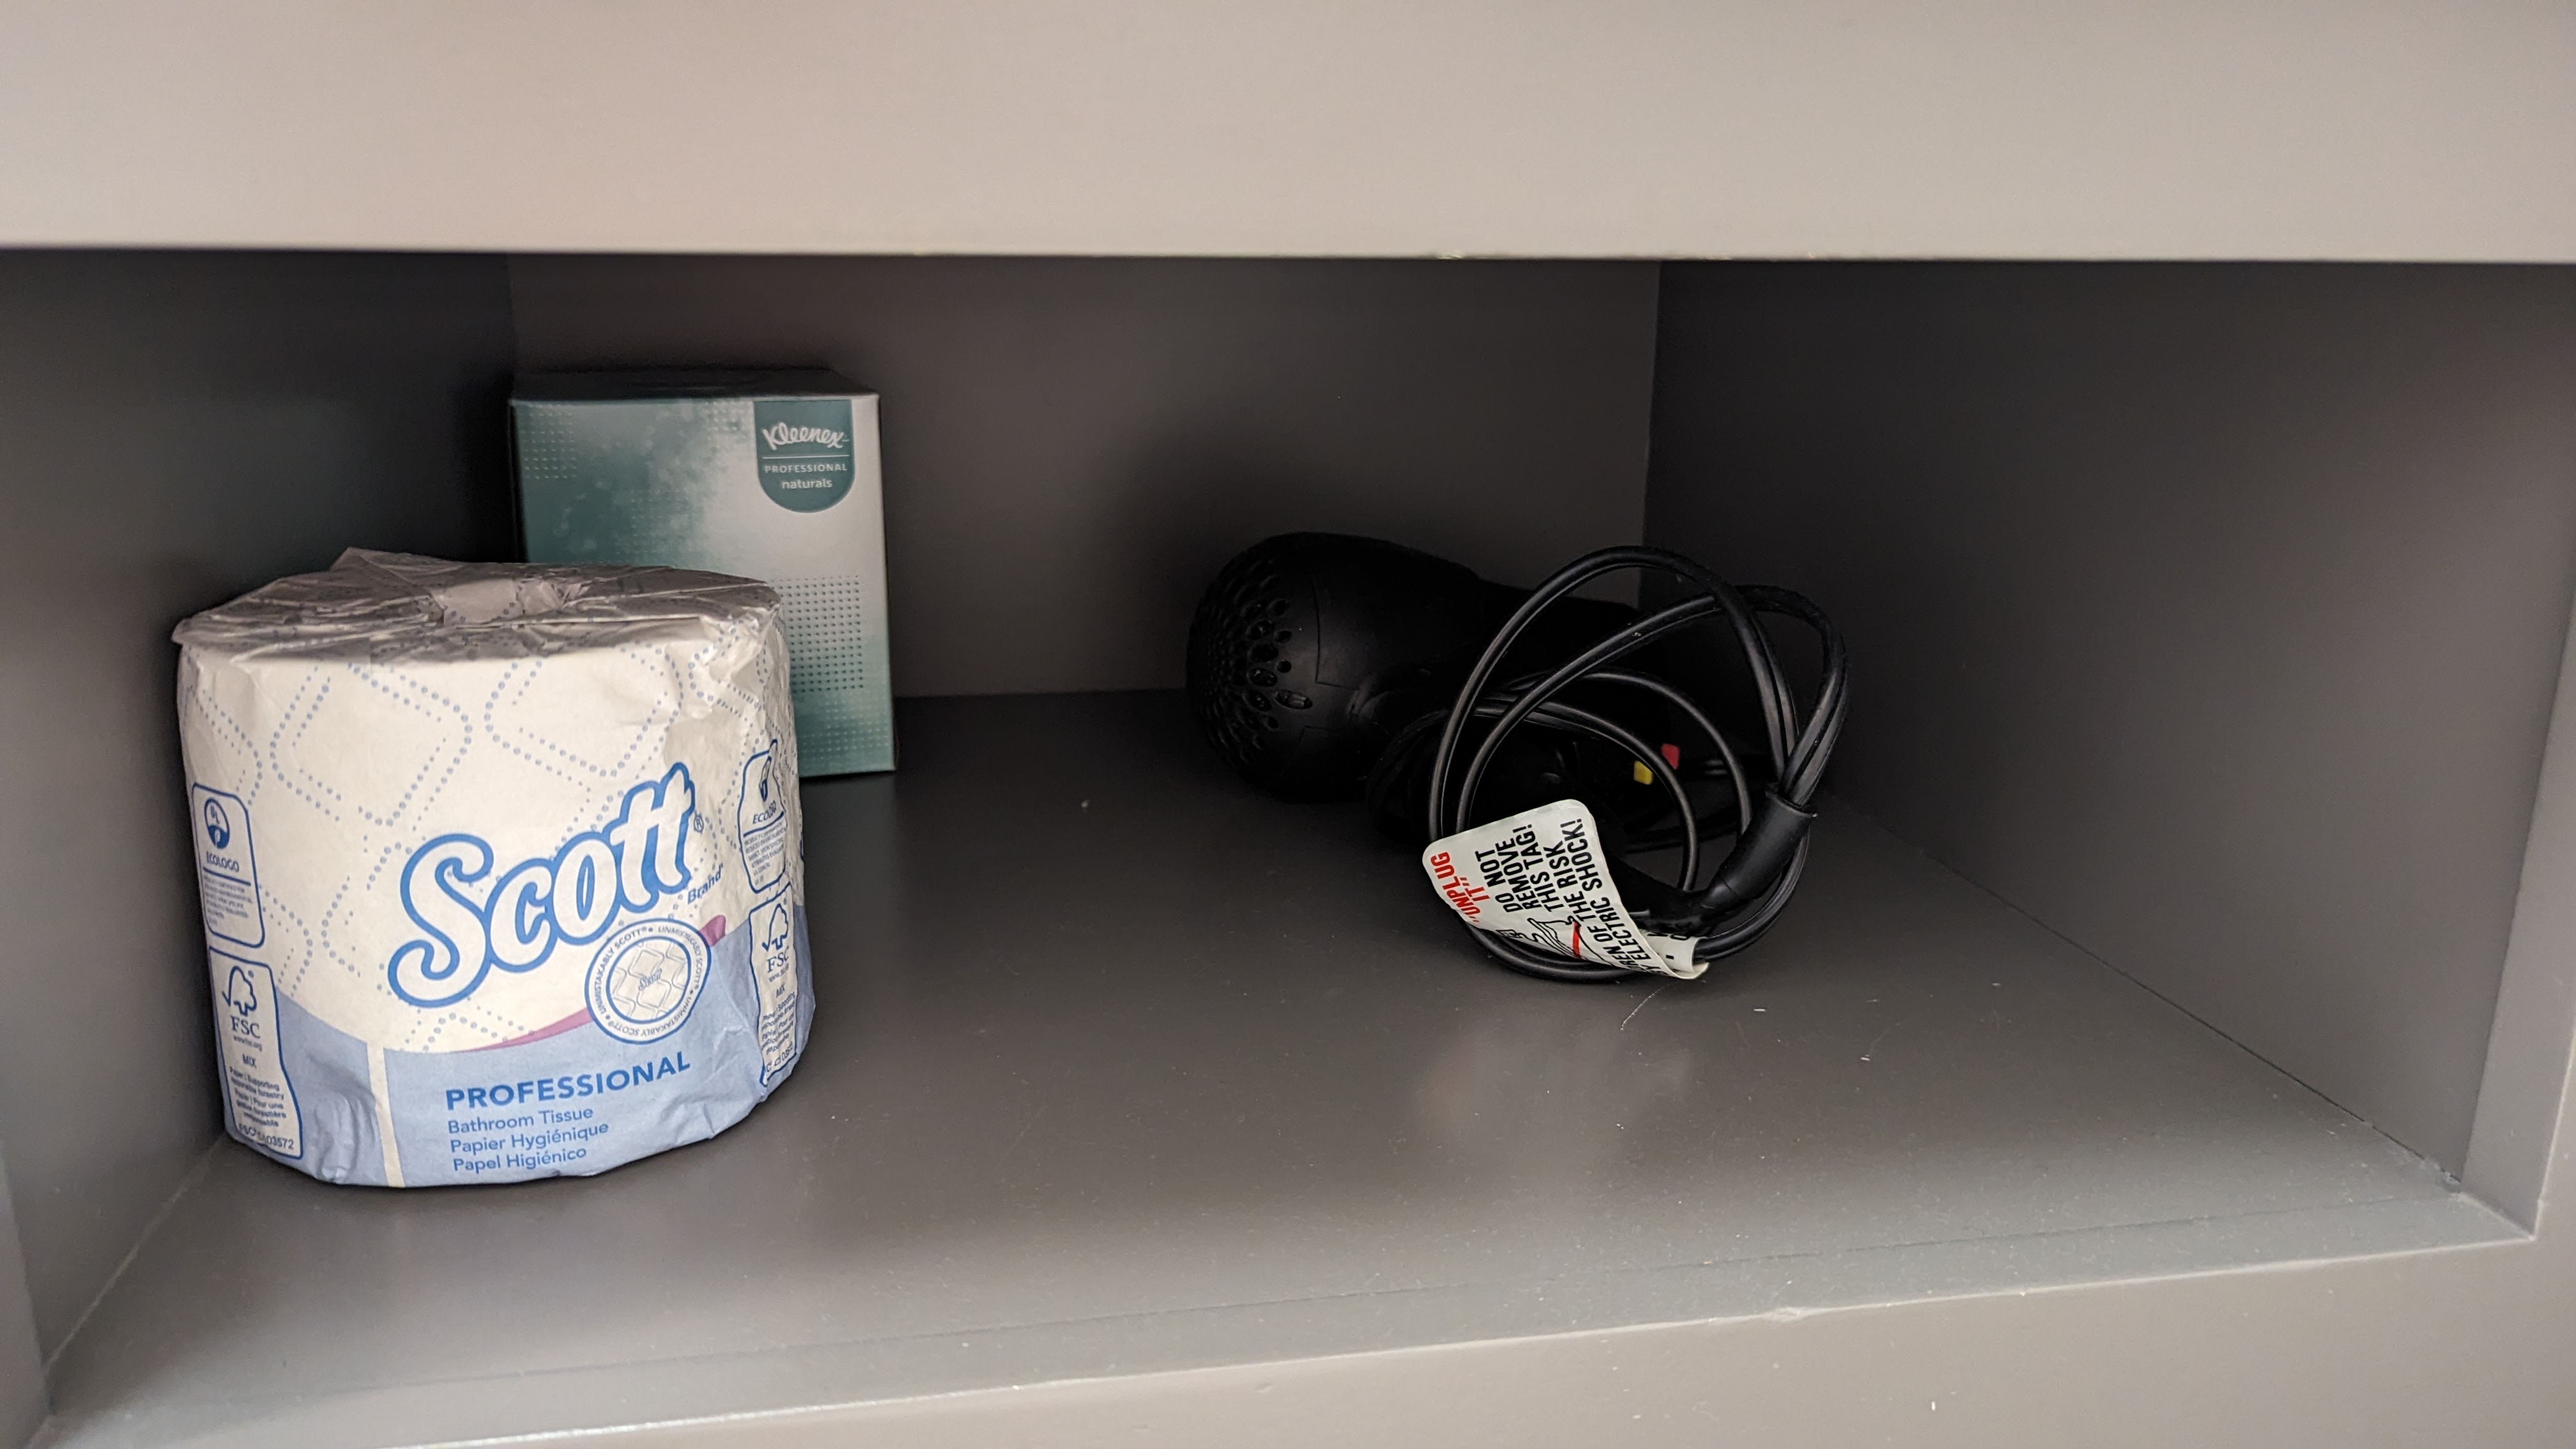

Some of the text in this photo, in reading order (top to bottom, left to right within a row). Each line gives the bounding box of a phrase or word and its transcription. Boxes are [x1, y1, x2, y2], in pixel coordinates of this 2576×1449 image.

[762, 422, 844, 450] Kleenex
[765, 464, 847, 473] PROFESSIONAL
[781, 479, 832, 489] naturals
[1512, 824, 1565, 912] THIS TAG!
[1543, 840, 1578, 889] RISK
[1560, 818, 1602, 891] SHOCK!
[687, 863, 723, 904] Brand
[1475, 849, 1524, 913] DO NOT
[1495, 838, 1542, 910] REMOVE
[1563, 891, 1597, 922] THE
[1586, 926, 1613, 942] OF
[1590, 896, 1652, 960] ELECTRIC
[767, 946, 789, 973] FSC
[231, 1015, 261, 1039] FSC
[447, 1052, 691, 1110] PROFESSIONAL
[448, 1108, 594, 1134] Bathroom Tissue
[450, 1123, 609, 1156] Papier Hygiénique
[453, 1147, 586, 1174] Papel Higiénico
